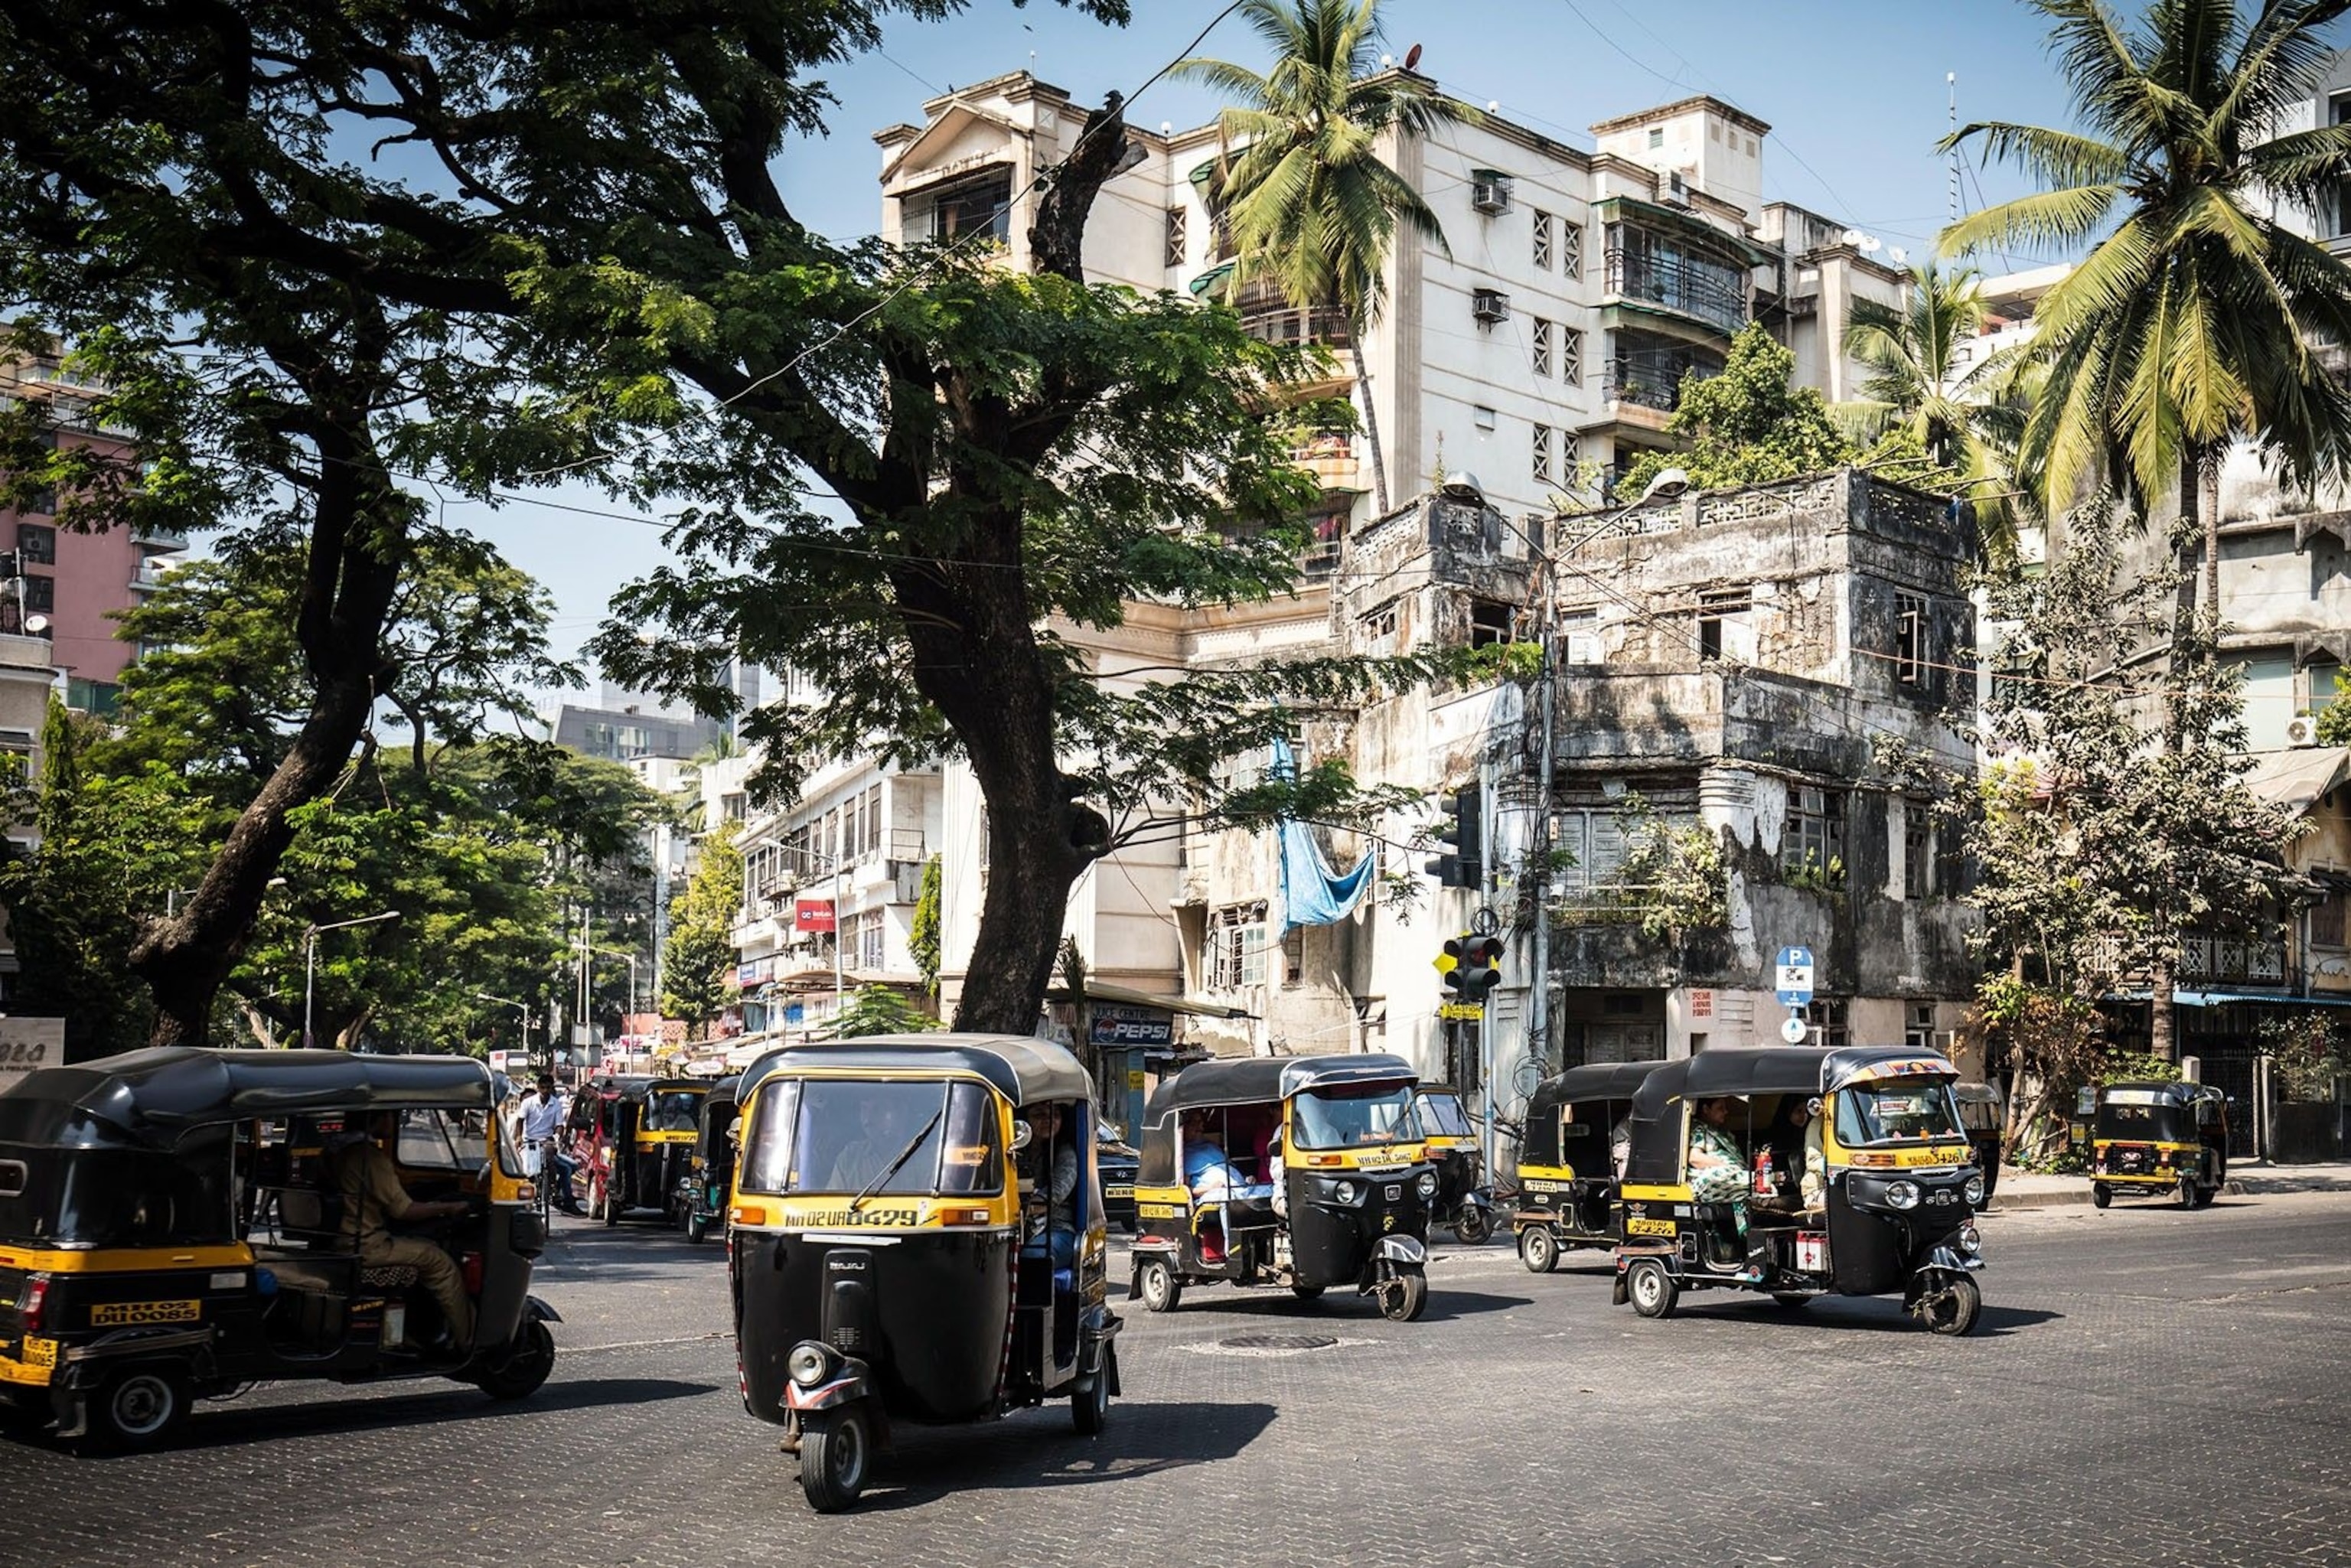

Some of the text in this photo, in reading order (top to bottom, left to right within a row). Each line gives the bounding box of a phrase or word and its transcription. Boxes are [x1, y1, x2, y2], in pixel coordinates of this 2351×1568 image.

[1790, 950, 1802, 965] P
[1114, 1023, 1169, 1039] PEPSI
[1933, 1153, 1959, 1164] 5426
[1632, 1225, 1674, 1234] 5426
[103, 1302, 191, 1313] MH 02
